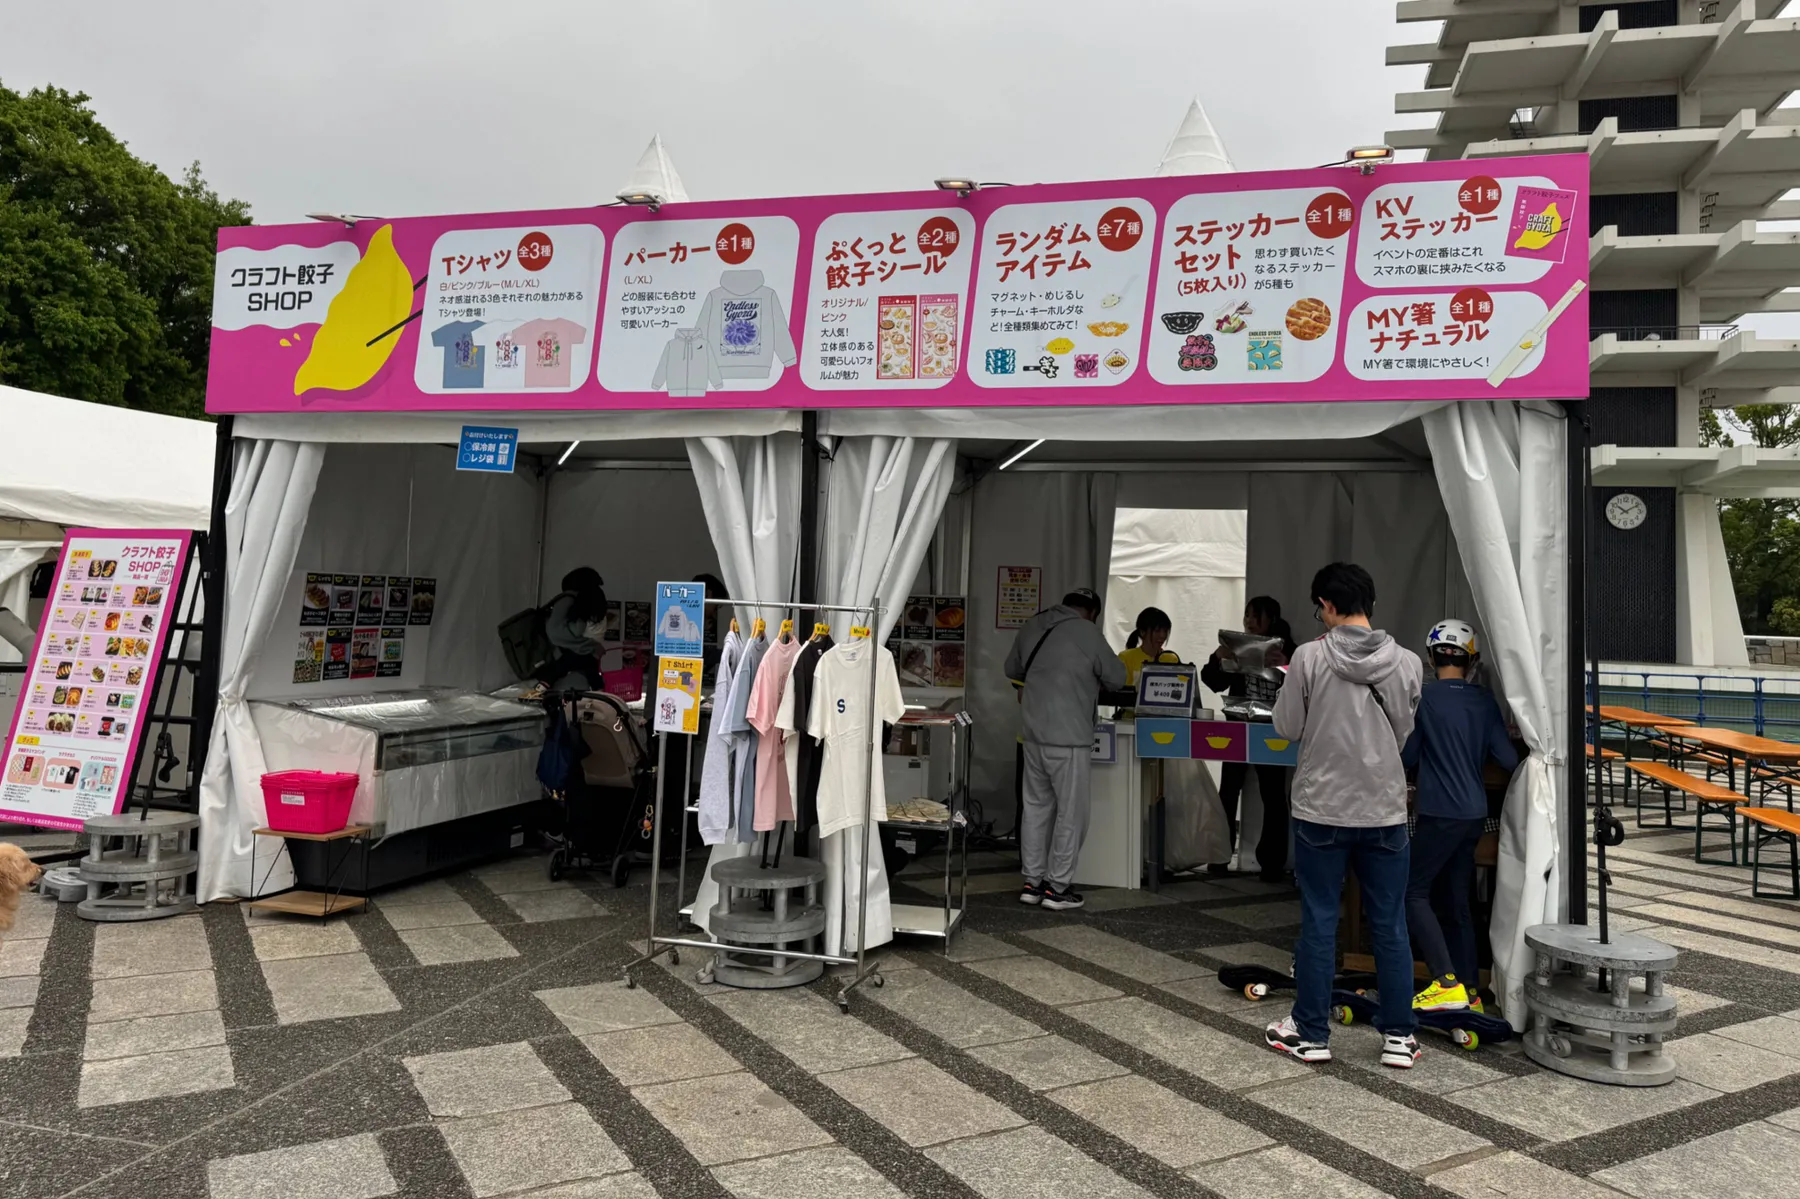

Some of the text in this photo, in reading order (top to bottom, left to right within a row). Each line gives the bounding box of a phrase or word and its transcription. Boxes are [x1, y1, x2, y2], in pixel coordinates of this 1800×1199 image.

[1460, 186, 1499, 203] 全1種
[1307, 204, 1352, 224] 全1種
[1376, 196, 1413, 219] KV
[1380, 211, 1498, 241] ステッカー
[1527, 213, 1554, 224] CRAFT
[1099, 219, 1140, 238] 全7種
[1174, 213, 1300, 247] ステッカー
[1526, 222, 1551, 233] GYOZA
[717, 234, 753, 252] 全1種
[919, 228, 957, 246] 全2種
[996, 222, 1092, 257] ランダム
[518, 242, 552, 259] 全3種
[624, 241, 711, 266] パーカー
[825, 232, 906, 262] ぷくっと
[1254, 245, 1335, 259] 思わず買いたく
[1373, 246, 1483, 260] イベントの定番はこれ
[442, 249, 512, 276] Tシャツ
[996, 250, 1092, 283] アイテム
[1174, 244, 1241, 273] セット
[231, 263, 334, 287] クラフト餃子
[825, 254, 947, 290] 餃子シール
[1254, 262, 1336, 274] なるステッカー
[1373, 262, 1506, 276] スマホの裏に挟みたくなる
[1177, 272, 1247, 296] (5枚入り)
[1254, 279, 1294, 290] が5種も
[247, 291, 313, 311] SHOP
[439, 291, 583, 304] ネオ感溢れる3色それぞれの魅力がある
[621, 291, 696, 302] どの服装にも合わせ
[990, 290, 1084, 302] マグネット・めじるし
[621, 305, 685, 315] やすいアッシュの
[723, 301, 760, 311] Endless
[990, 305, 1084, 317] チャーム・キーホルダな
[1451, 298, 1491, 316] 全1種
[724, 310, 758, 322] Gyoza
[821, 313, 847, 323] ピンク
[1367, 302, 1435, 329] MY箸
[620, 319, 678, 329] 可愛いパーカー
[1370, 323, 1489, 353] ナチュラル
[820, 341, 875, 352] 立体感のある
[820, 356, 873, 366] 可愛らしいフォ
[819, 371, 859, 380] ルムが魅力
[121, 546, 176, 559] クラフト餃子
[128, 561, 161, 572] SHOP
[673, 661, 693, 669] Shirt
[837, 698, 846, 714] S
